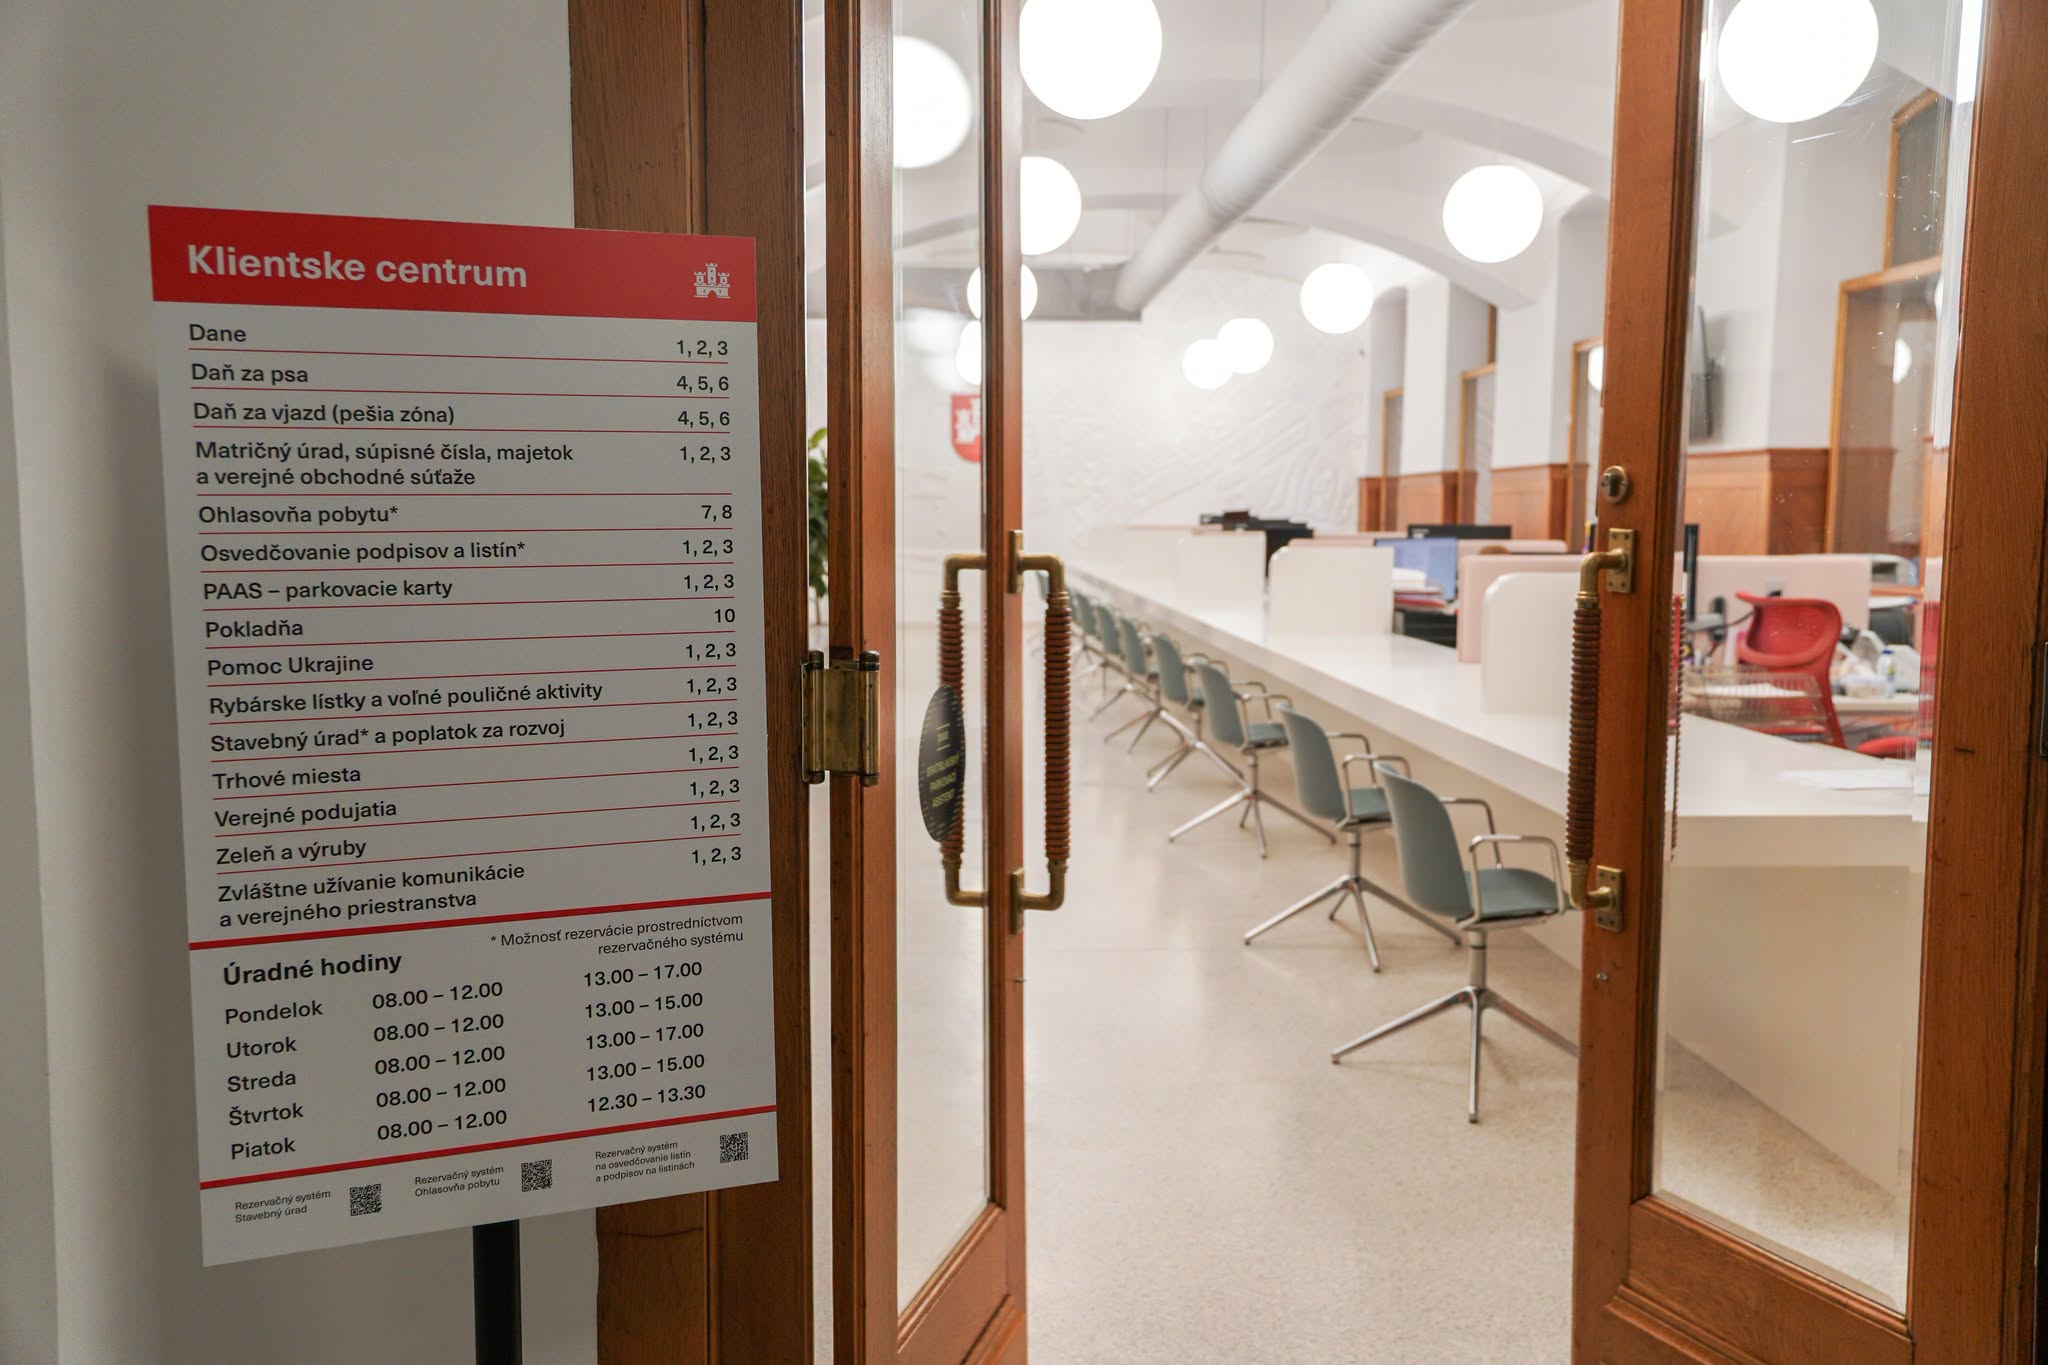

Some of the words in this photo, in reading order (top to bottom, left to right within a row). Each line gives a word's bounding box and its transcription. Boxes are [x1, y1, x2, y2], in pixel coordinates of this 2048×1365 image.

[189, 245, 365, 280] Klientske
[376, 259, 526, 287] centrum
[189, 323, 247, 343] Dane
[677, 339, 692, 358] 1,
[696, 340, 712, 358] 2,
[717, 340, 728, 356] 3
[191, 363, 235, 381] Daň
[240, 369, 265, 382] za
[271, 369, 309, 386] psa
[676, 375, 693, 394] 4,
[698, 376, 713, 394] 5,
[718, 376, 729, 391] 6
[193, 402, 237, 420] Daň
[242, 407, 267, 420] za
[271, 403, 326, 425] vjazd
[332, 404, 395, 425] (pešia
[400, 406, 455, 426] zóna)
[677, 410, 694, 429] 4,
[698, 411, 714, 429] 5,
[719, 411, 730, 426] 6
[195, 441, 292, 463] Matričný
[297, 442, 350, 462] úrad,
[355, 443, 435, 463] súpisné
[440, 443, 491, 463] čísla,
[497, 444, 574, 464] majetok
[680, 446, 695, 464] 1,
[699, 446, 715, 464] 2,
[720, 446, 731, 461] 3
[196, 472, 209, 485] a
[214, 468, 295, 489] verejné
[300, 468, 405, 485] obchodné
[410, 468, 476, 485] súťaže
[198, 506, 312, 523] Ohlasovňa
[701, 504, 717, 523] 7,
[722, 504, 733, 520] 8
[200, 543, 351, 562] Osvedčovanie
[356, 542, 449, 563] podpisov
[453, 546, 465, 558] a
[682, 539, 698, 558] 1,
[702, 539, 718, 557] 2,
[722, 539, 734, 554] 3
[203, 582, 263, 600] PAAS
[286, 580, 398, 602] parkovacie
[403, 579, 453, 599] karty
[683, 574, 699, 593] 1,
[703, 574, 719, 592] 2,
[723, 573, 735, 589] 3
[714, 608, 736, 623] 10
[205, 619, 304, 638] Pokladňa
[685, 644, 701, 662] 1,
[705, 643, 721, 661] 2,
[725, 642, 737, 657] 3
[207, 659, 282, 677] Pomoc
[288, 655, 374, 676] Ukrajine
[686, 678, 702, 696] 1,
[706, 677, 722, 695] 2,
[726, 676, 737, 692] 3
[209, 694, 307, 718] Rybárske
[312, 692, 366, 712] lístky
[371, 695, 383, 707] a
[387, 688, 442, 706] voľné
[447, 685, 531, 708] pouličné
[536, 682, 603, 701] aktivity
[687, 713, 703, 730] 1,
[707, 711, 723, 729] 2,
[727, 710, 738, 726] 3
[210, 731, 309, 752] Stavebný
[374, 731, 387, 744] a
[392, 723, 479, 747] poplatok
[482, 725, 504, 738] za
[509, 718, 565, 738] rozvoj
[688, 747, 703, 765] 1,
[708, 746, 724, 763] 2,
[728, 745, 739, 760] 3
[211, 770, 286, 790] Trhové
[291, 768, 361, 786] miesta
[689, 781, 704, 799] 1,
[709, 780, 725, 797] 2,
[729, 778, 740, 794] 3
[214, 806, 296, 829] Verejné
[301, 800, 397, 826] podujatia
[690, 815, 705, 833] 1,
[710, 814, 726, 831] 2,
[730, 812, 741, 827] 3
[216, 845, 276, 865] Zeleň
[281, 847, 293, 863] a
[297, 839, 367, 862] výruby
[691, 849, 706, 866] 1,
[711, 847, 726, 865] 2,
[731, 846, 742, 861] 3
[218, 882, 308, 902] Zvláštne
[313, 873, 397, 895] užívanie
[402, 863, 525, 888] komunikácie
[219, 914, 232, 928] a
[236, 903, 342, 926] verejného
[347, 893, 477, 921] priestranstva
[501, 929, 562, 946] Možnosť
[565, 923, 634, 941] rezervácie
[637, 914, 743, 937] prostredníctvom
[598, 935, 688, 955] rezervačného
[690, 931, 744, 948] systému
[223, 959, 314, 986] Úradné
[320, 953, 402, 976] hodiny
[584, 968, 634, 987] 13.00
[653, 961, 702, 980] 17.00
[372, 989, 428, 1009] 08.00
[450, 981, 503, 1001] 12.00
[585, 999, 635, 1019] 13.00
[654, 992, 703, 1011] 15.00
[225, 1000, 323, 1025] Pondelok
[373, 1022, 429, 1042] 08.00
[451, 1013, 504, 1033] 12.00
[586, 1031, 636, 1050] 13.00
[655, 1023, 704, 1042] 17.00
[226, 1036, 297, 1059] Utorok
[375, 1054, 430, 1075] 08.00
[452, 1046, 505, 1066] 12.00
[587, 1062, 637, 1081] 13.00
[656, 1053, 705, 1073] 15.00
[227, 1070, 296, 1093] Streda
[376, 1087, 432, 1108] 08.00
[453, 1078, 506, 1098] 12.00
[588, 1093, 638, 1113] 12.30
[657, 1084, 706, 1104] 13.30
[229, 1102, 304, 1126] Štvrtok
[377, 1119, 433, 1141] 08.00
[454, 1110, 507, 1130] 12.00
[231, 1137, 296, 1160] Piatok
[595, 1145, 646, 1160] Rezervačný
[647, 1141, 678, 1154] systém
[595, 1163, 607, 1171] na
[608, 1153, 669, 1170] osvedčovanie
[595, 1175, 602, 1183] a
[603, 1169, 644, 1183] podpisov
[645, 1167, 657, 1175] na
[658, 1161, 695, 1173] listinách
[414, 1169, 469, 1185] Rezervačný
[471, 1166, 504, 1179] systém
[414, 1182, 465, 1197] Ohlasovňa
[467, 1178, 500, 1192] pobytu
[235, 1194, 294, 1210] Rezervačný
[295, 1190, 331, 1204] systém
[235, 1208, 283, 1223] Stavebný
[284, 1204, 307, 1216] úrad
